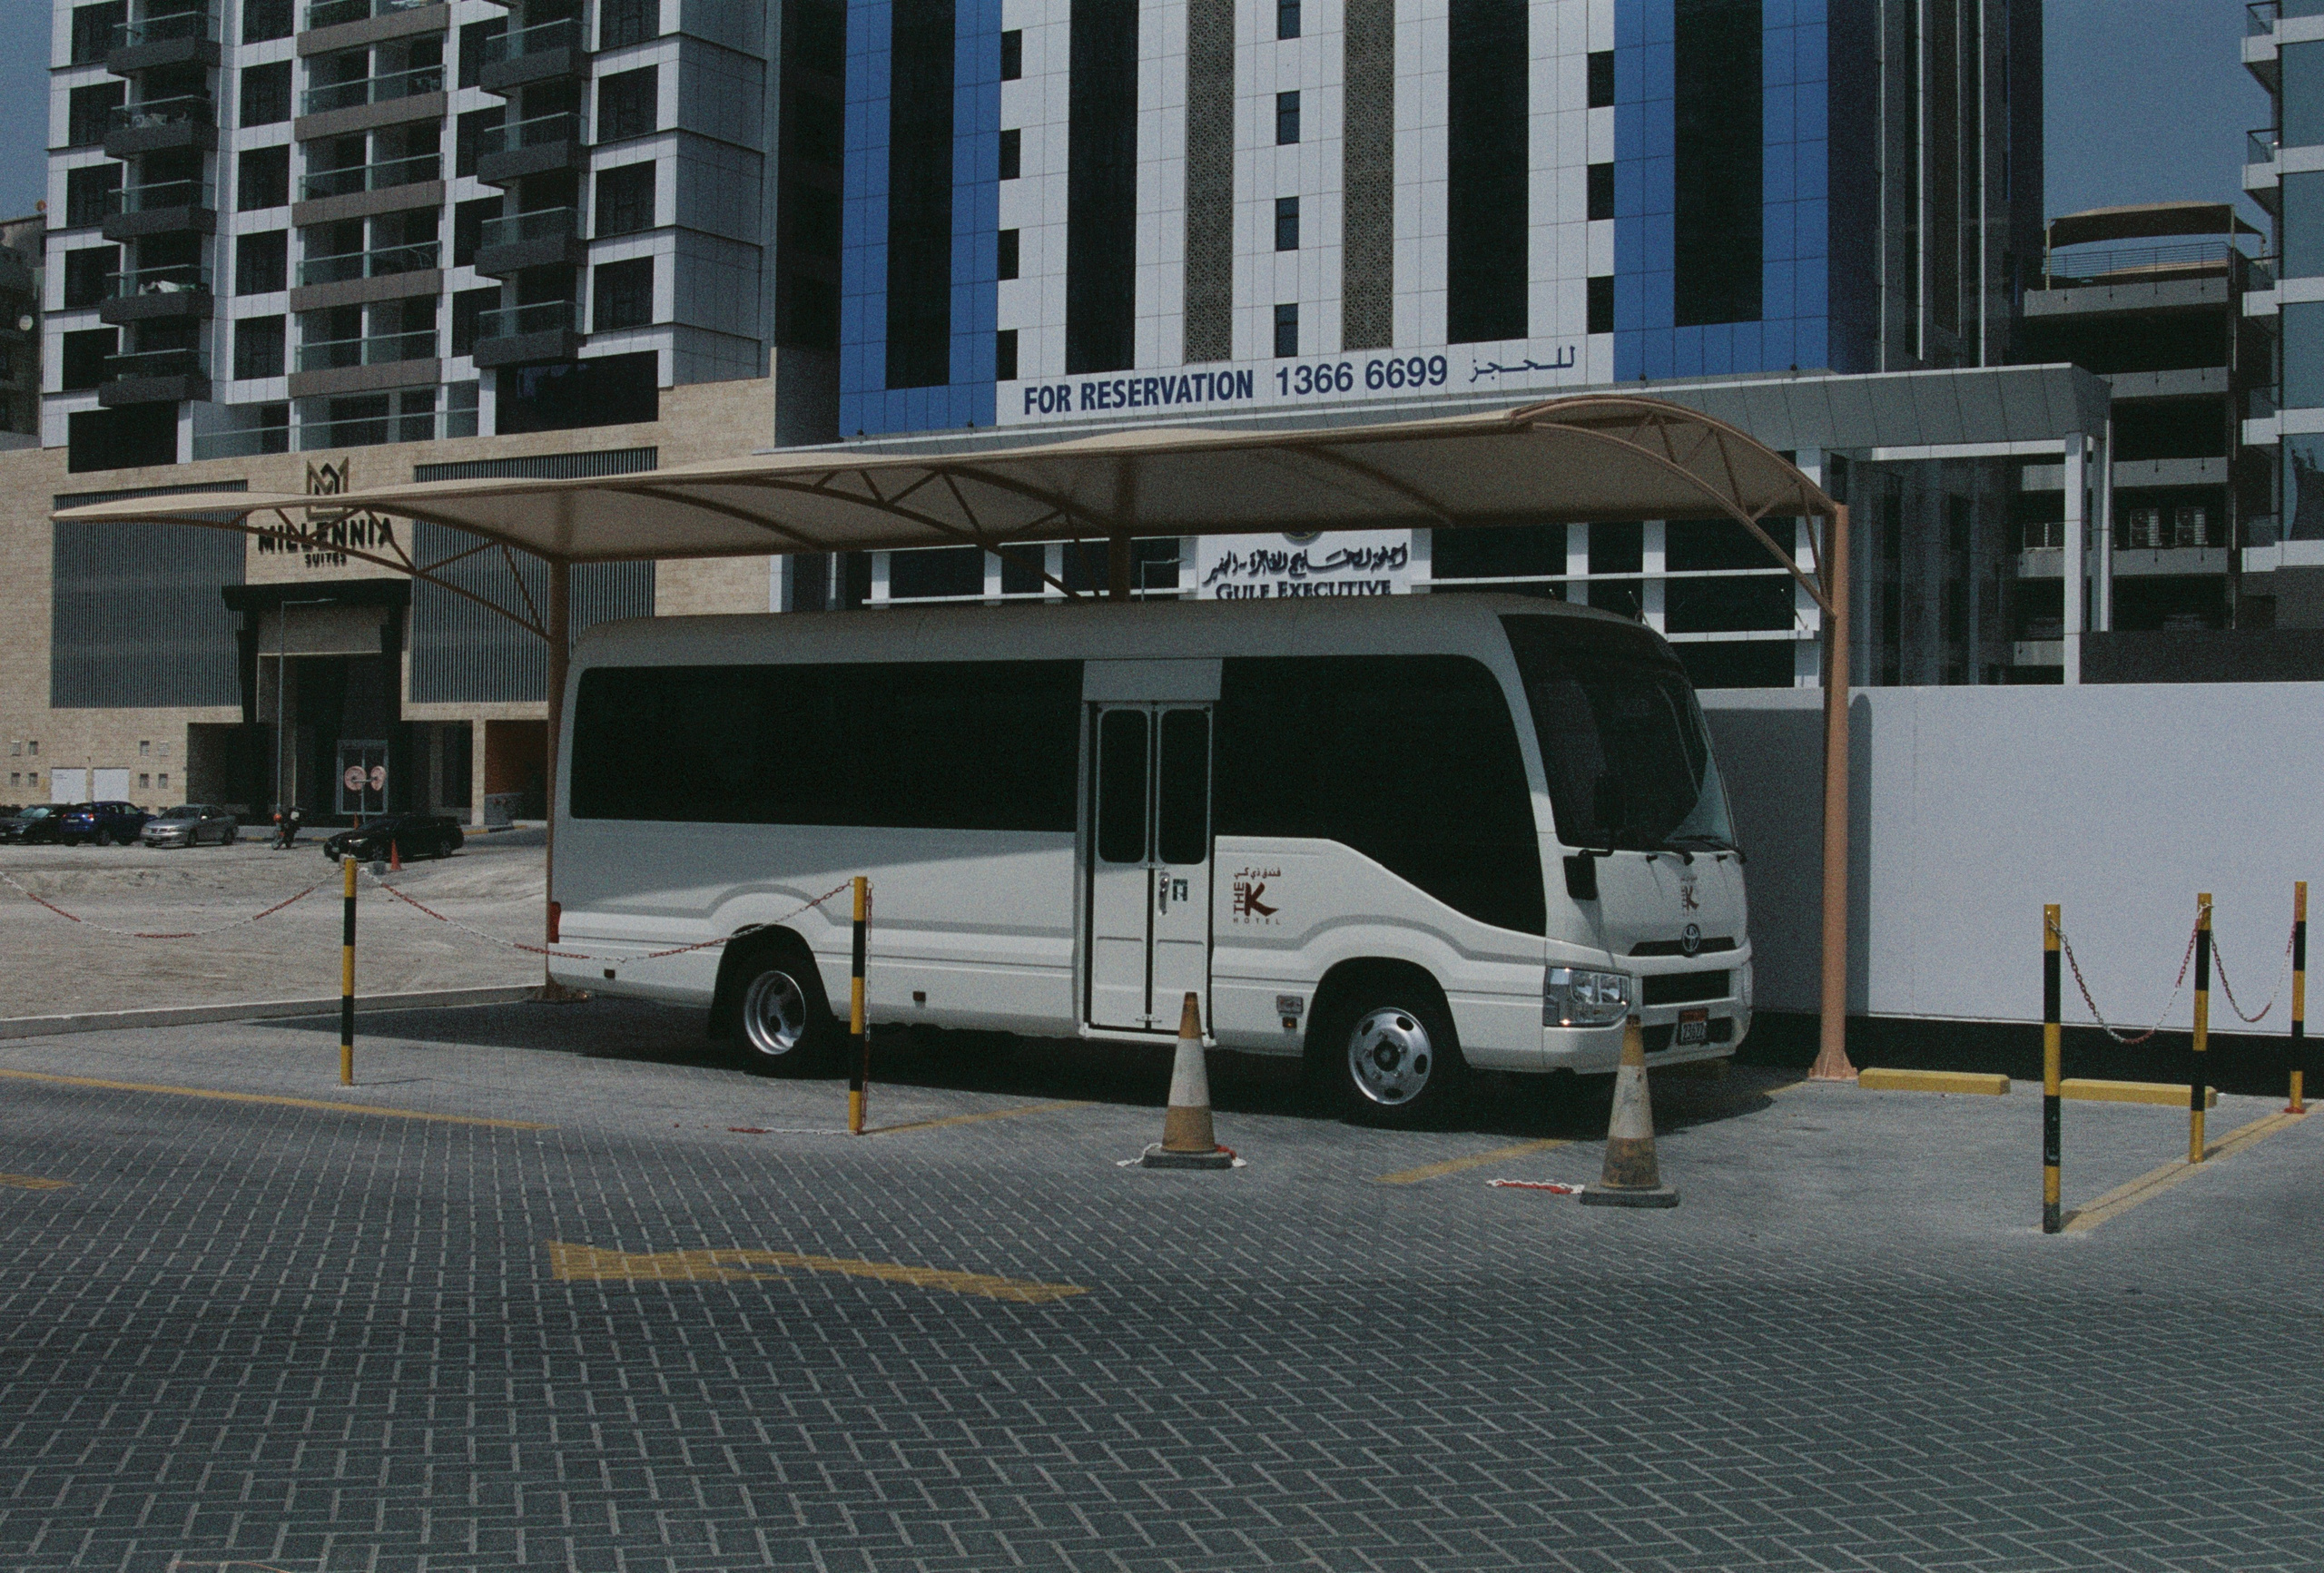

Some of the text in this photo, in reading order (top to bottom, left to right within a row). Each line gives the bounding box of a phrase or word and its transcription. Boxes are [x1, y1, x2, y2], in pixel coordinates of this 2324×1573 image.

[1469, 345, 1576, 383] للحجز
[1024, 355, 1448, 415] FOR RESERVATION 1366 6699
[259, 517, 396, 552] MILLENNIA
[305, 552, 348, 566] SUITES
[1216, 580, 1392, 599] GULF EXECUTIVE
[1262, 867, 1281, 880] فندق
[1233, 881, 1280, 917] THE K
[1233, 917, 1281, 926] HOTEL
